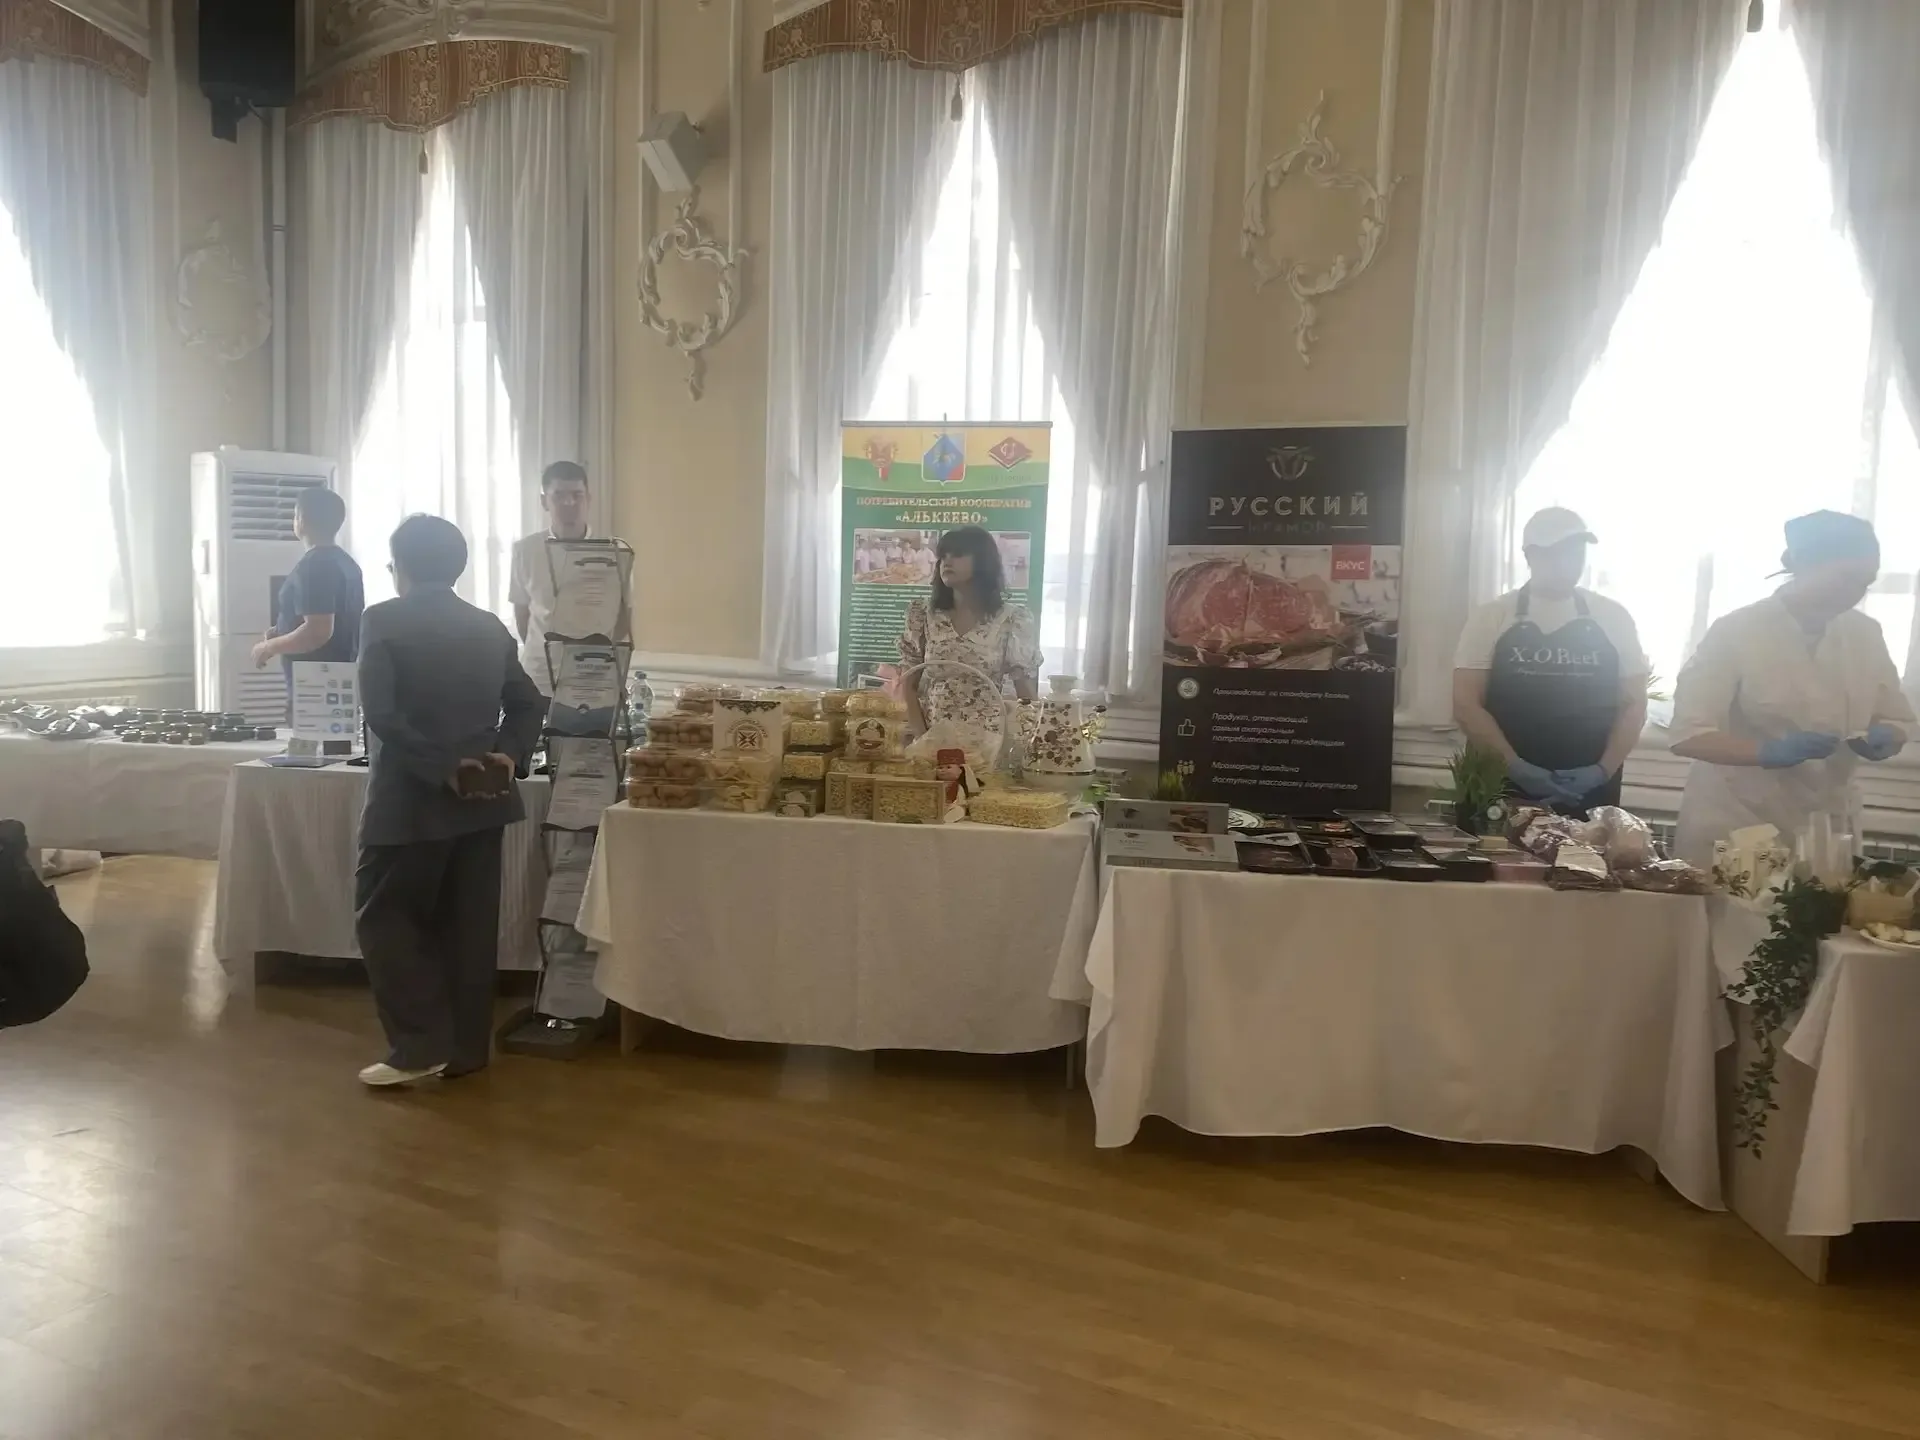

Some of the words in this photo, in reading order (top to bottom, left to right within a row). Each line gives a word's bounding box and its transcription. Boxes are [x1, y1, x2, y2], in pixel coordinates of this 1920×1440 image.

[1208, 492, 1369, 516] РУССКИЙ
[895, 510, 988, 524] «АЛЬКЕЕВО»
[1335, 560, 1365, 570] ВКУС
